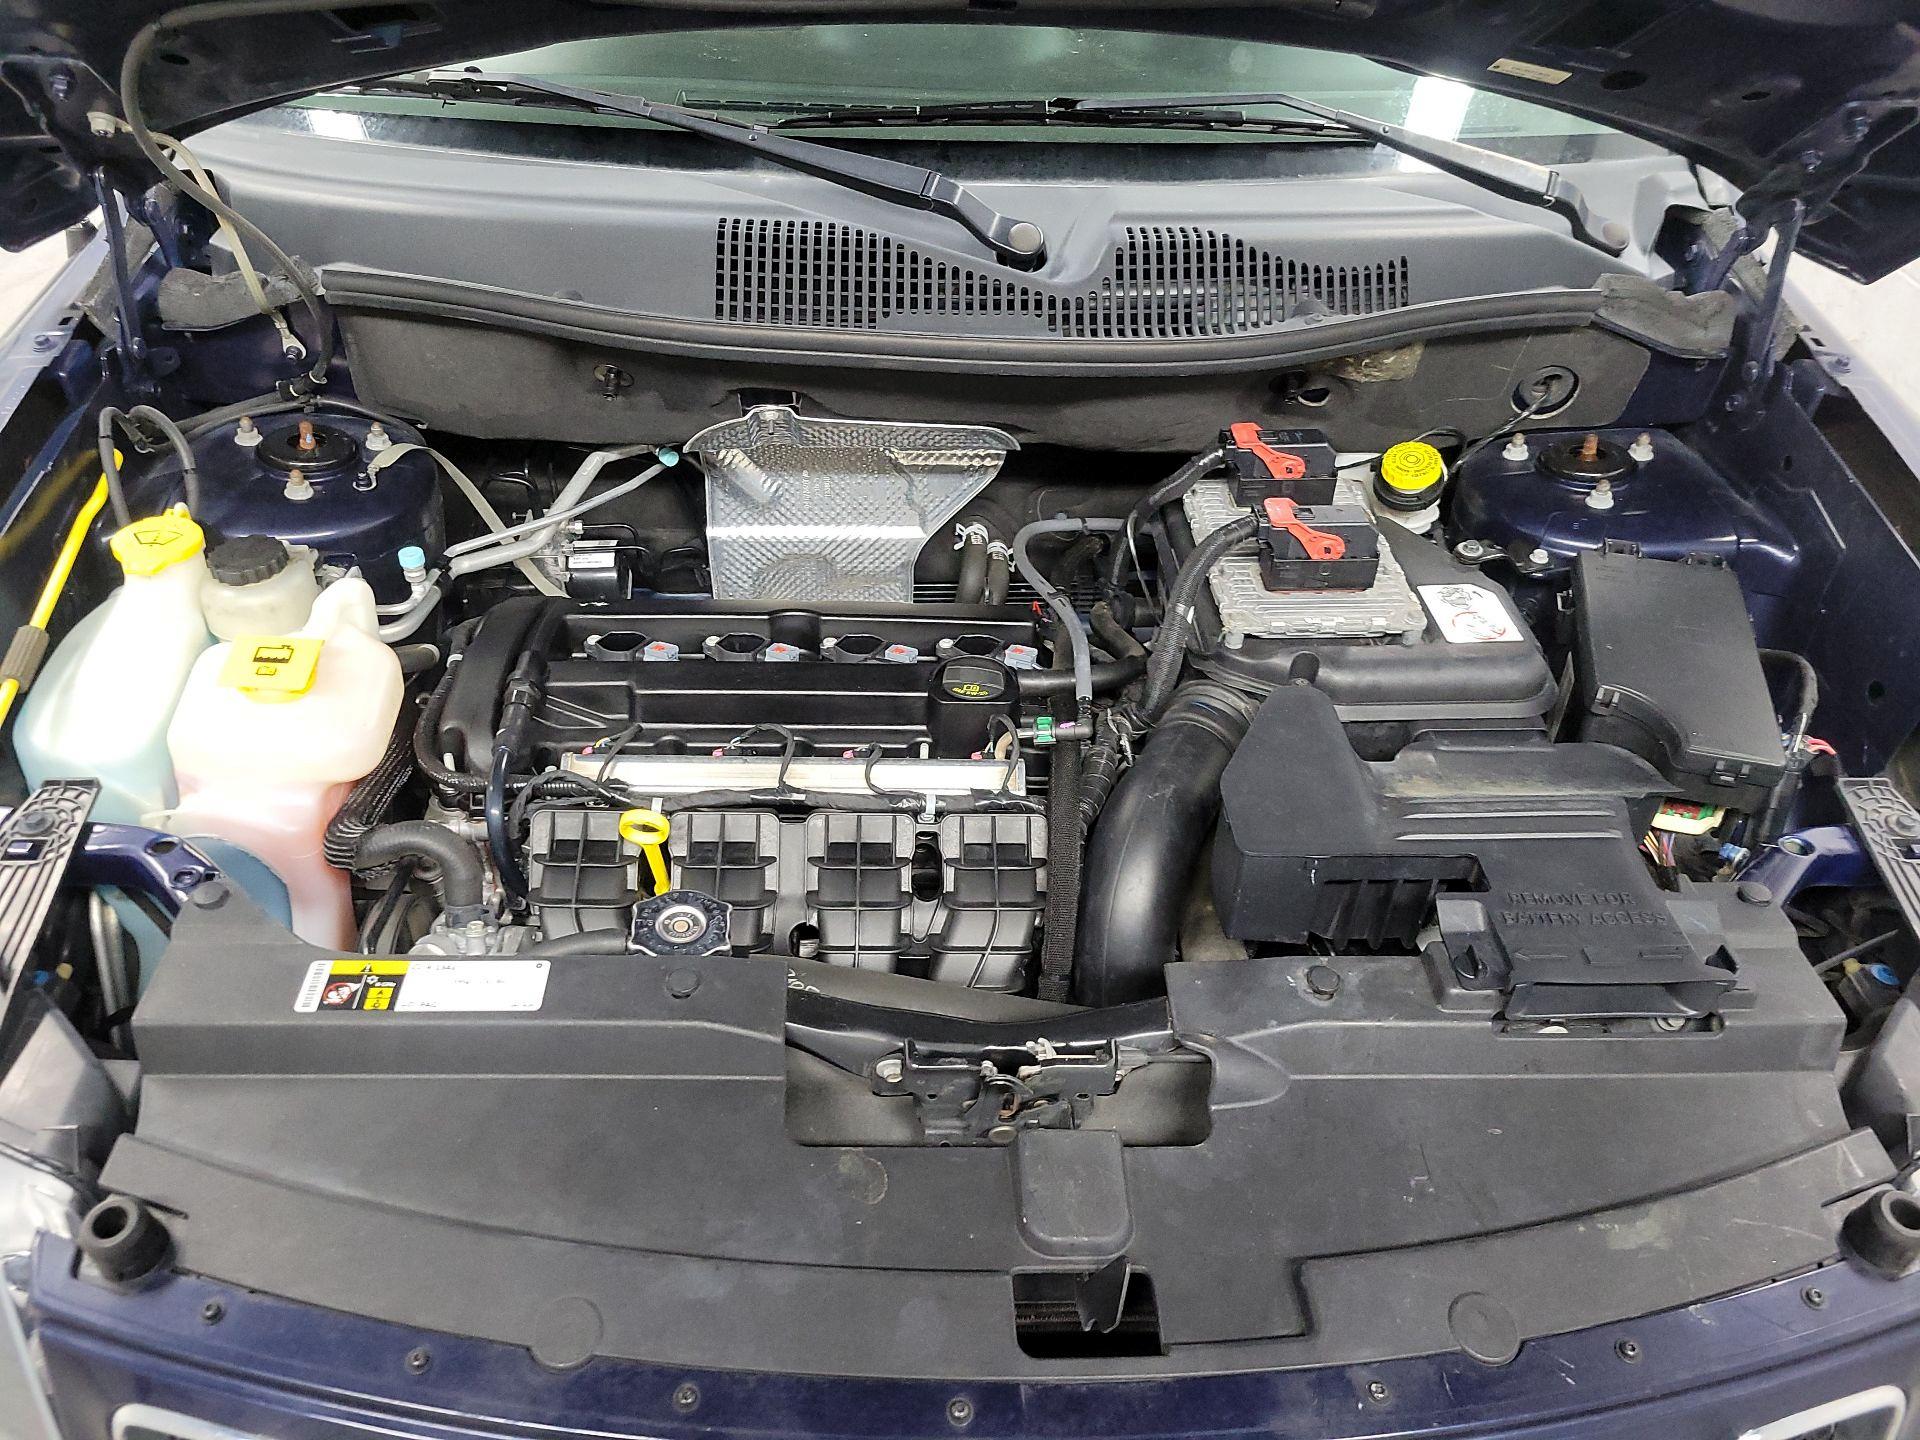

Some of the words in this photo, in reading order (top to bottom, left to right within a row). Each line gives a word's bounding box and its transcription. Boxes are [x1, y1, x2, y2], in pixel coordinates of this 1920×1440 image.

[1507, 891, 1591, 906] REMOVE
[1592, 892, 1635, 906] FOR
[1502, 911, 1580, 926] BATTERY
[1590, 911, 1668, 926] ACCESS
